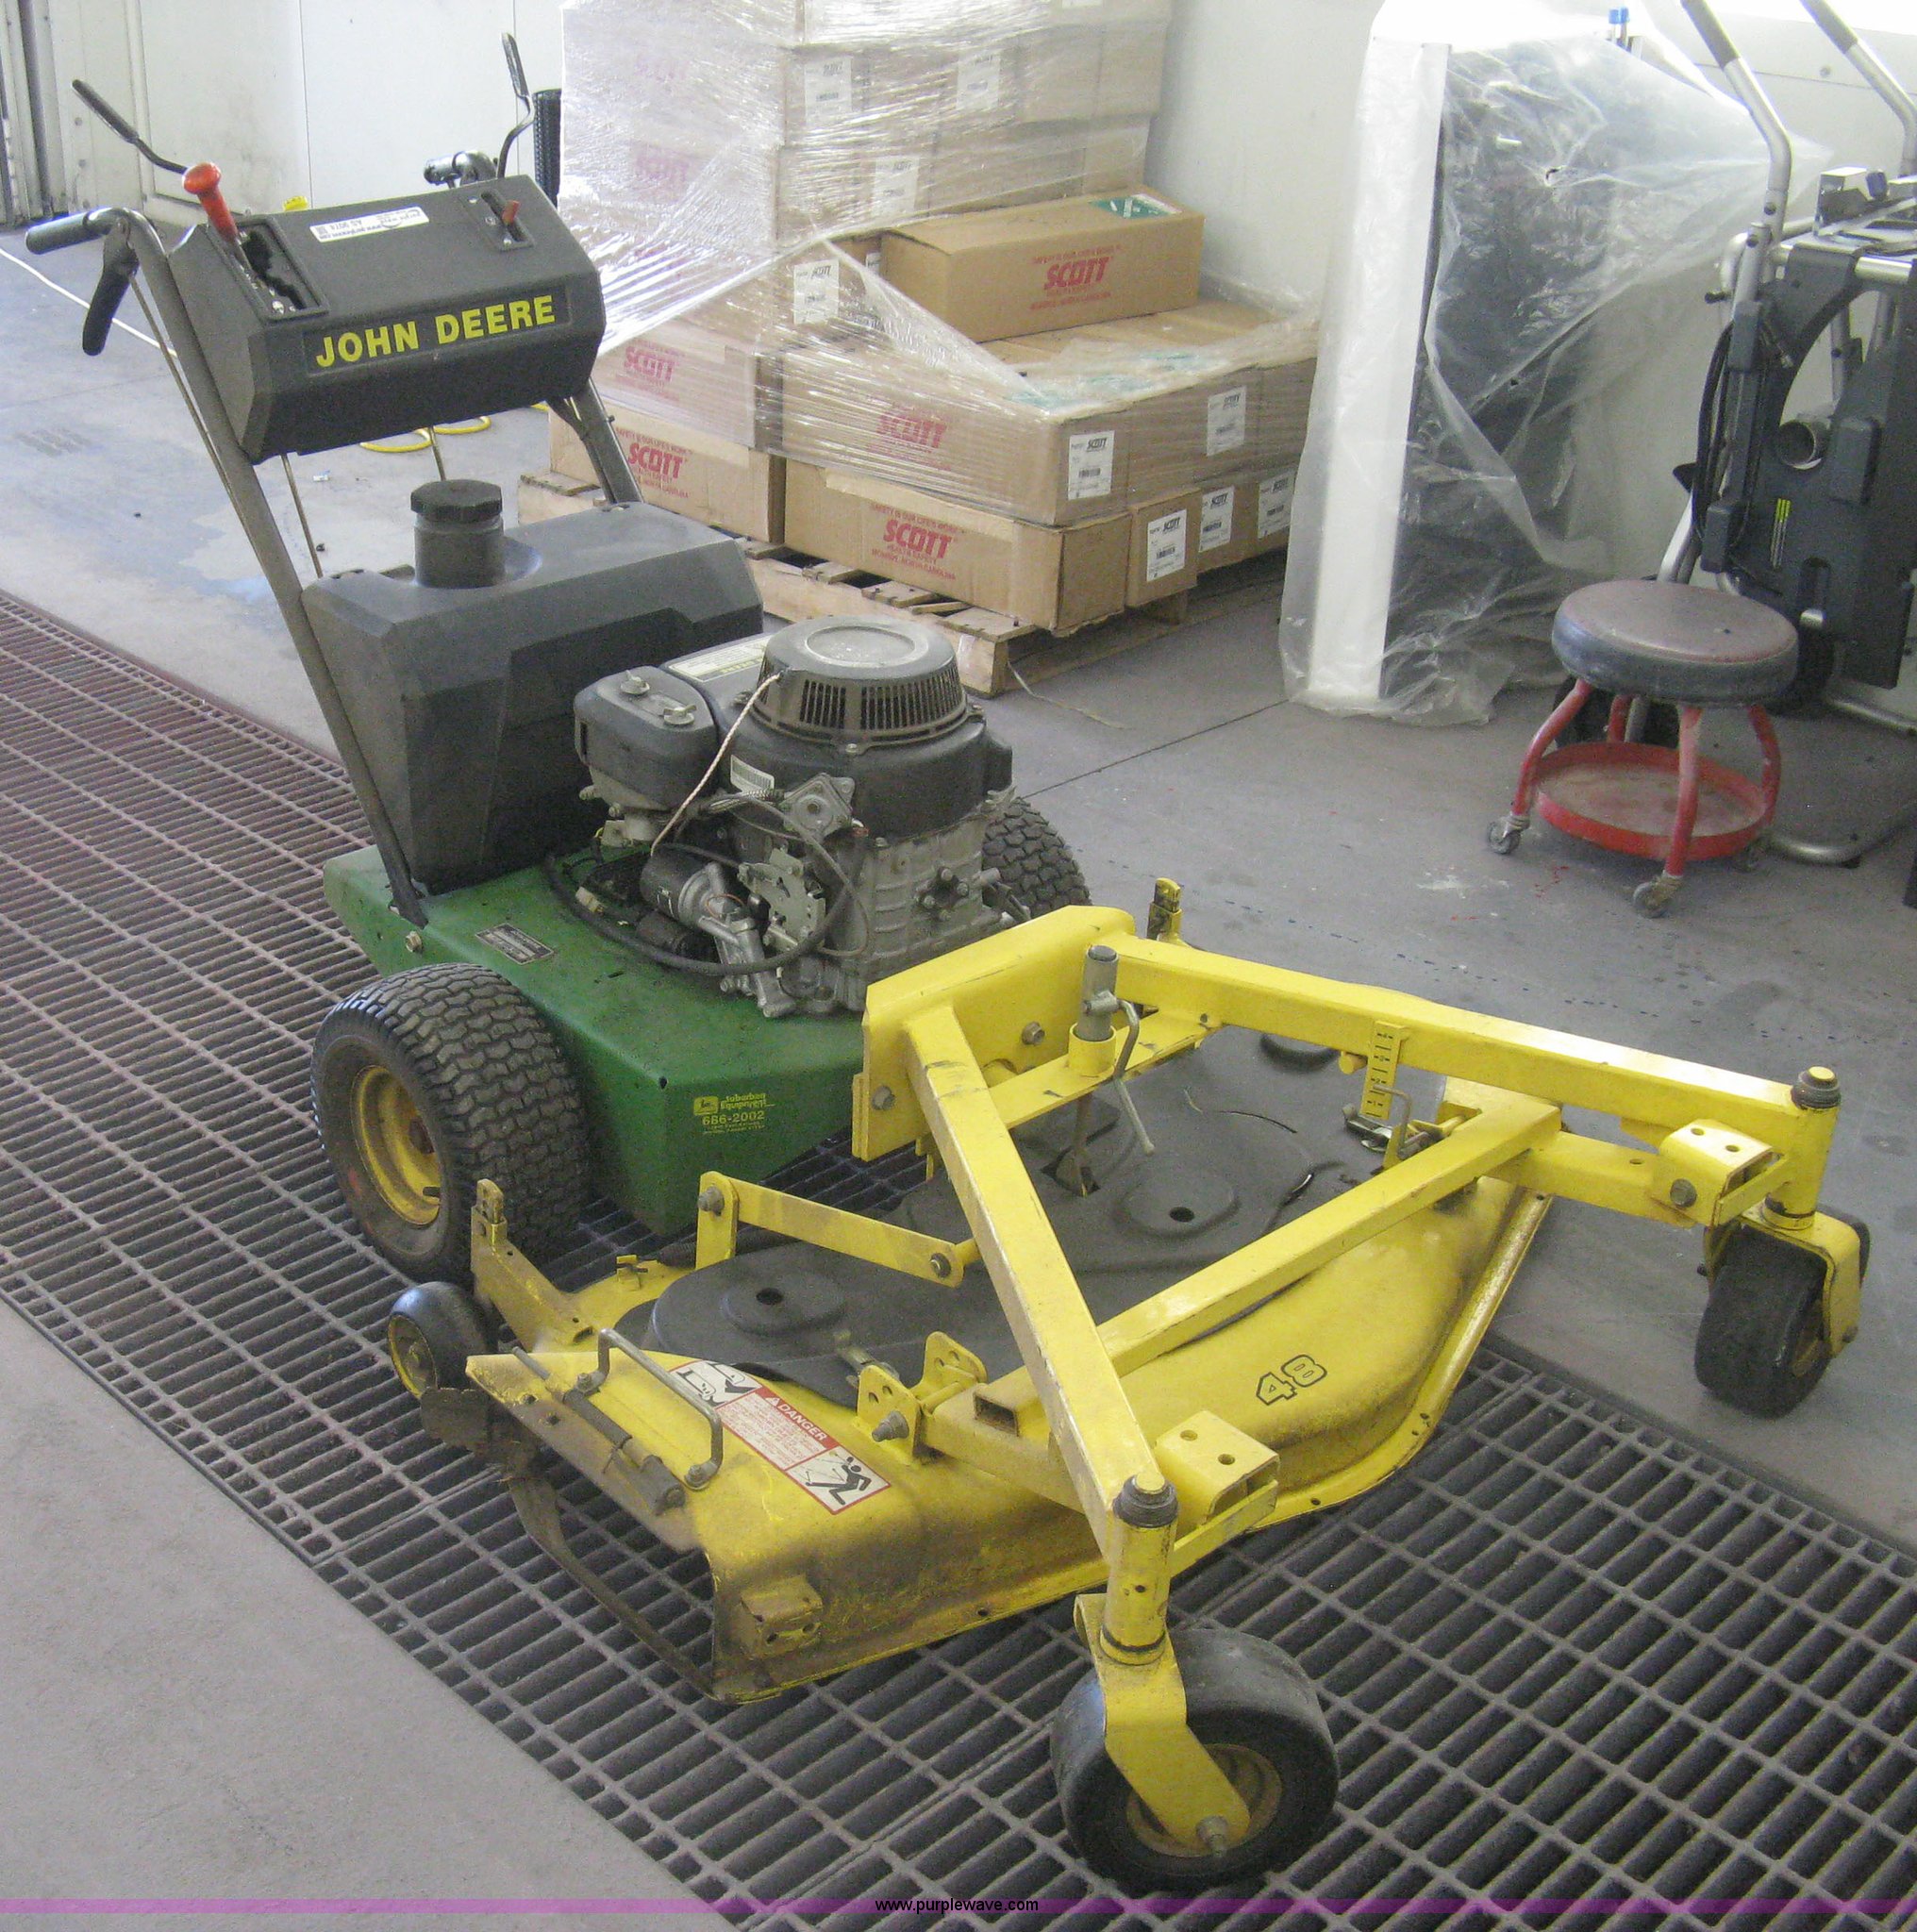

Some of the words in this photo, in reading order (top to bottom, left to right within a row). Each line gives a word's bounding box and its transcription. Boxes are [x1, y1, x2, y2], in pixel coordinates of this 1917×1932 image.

[1044, 256, 1111, 291] SCOTT
[316, 321, 420, 368] JOHN
[435, 294, 556, 344] DEERE
[625, 346, 677, 382] SCOTT
[876, 414, 947, 449] SCOTT
[627, 442, 683, 479] SCOTT
[883, 519, 953, 559] SCOTT
[702, 1110, 765, 1126] 686-2002
[1256, 1354, 1327, 1406] 48
[777, 1402, 828, 1441] DANGER
